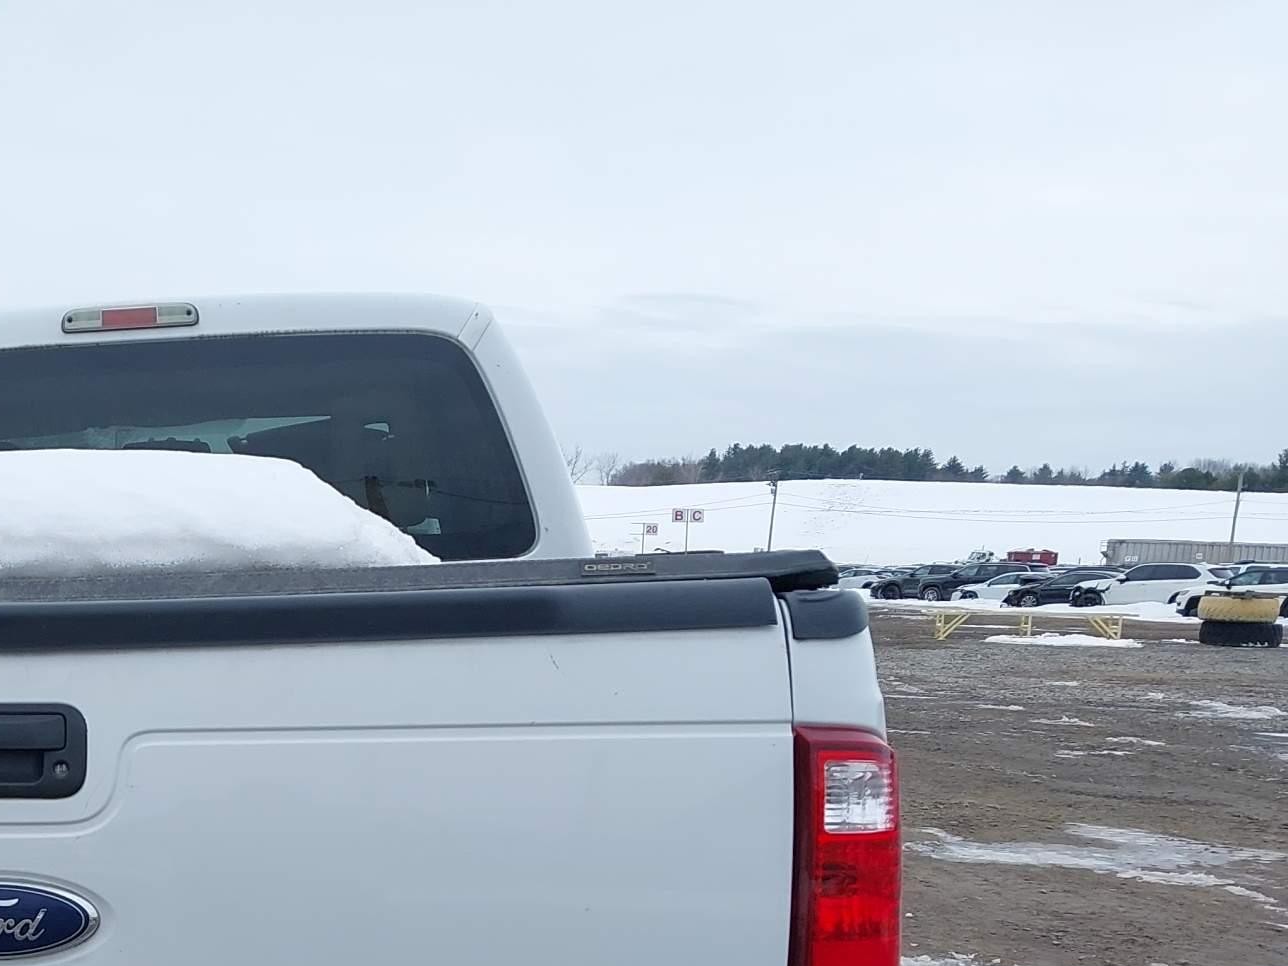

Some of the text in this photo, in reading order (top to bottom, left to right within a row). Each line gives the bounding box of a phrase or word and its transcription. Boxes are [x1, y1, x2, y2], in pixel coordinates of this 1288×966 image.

[675, 511, 684, 521] B
[692, 511, 702, 521] C
[645, 525, 658, 534] 20
